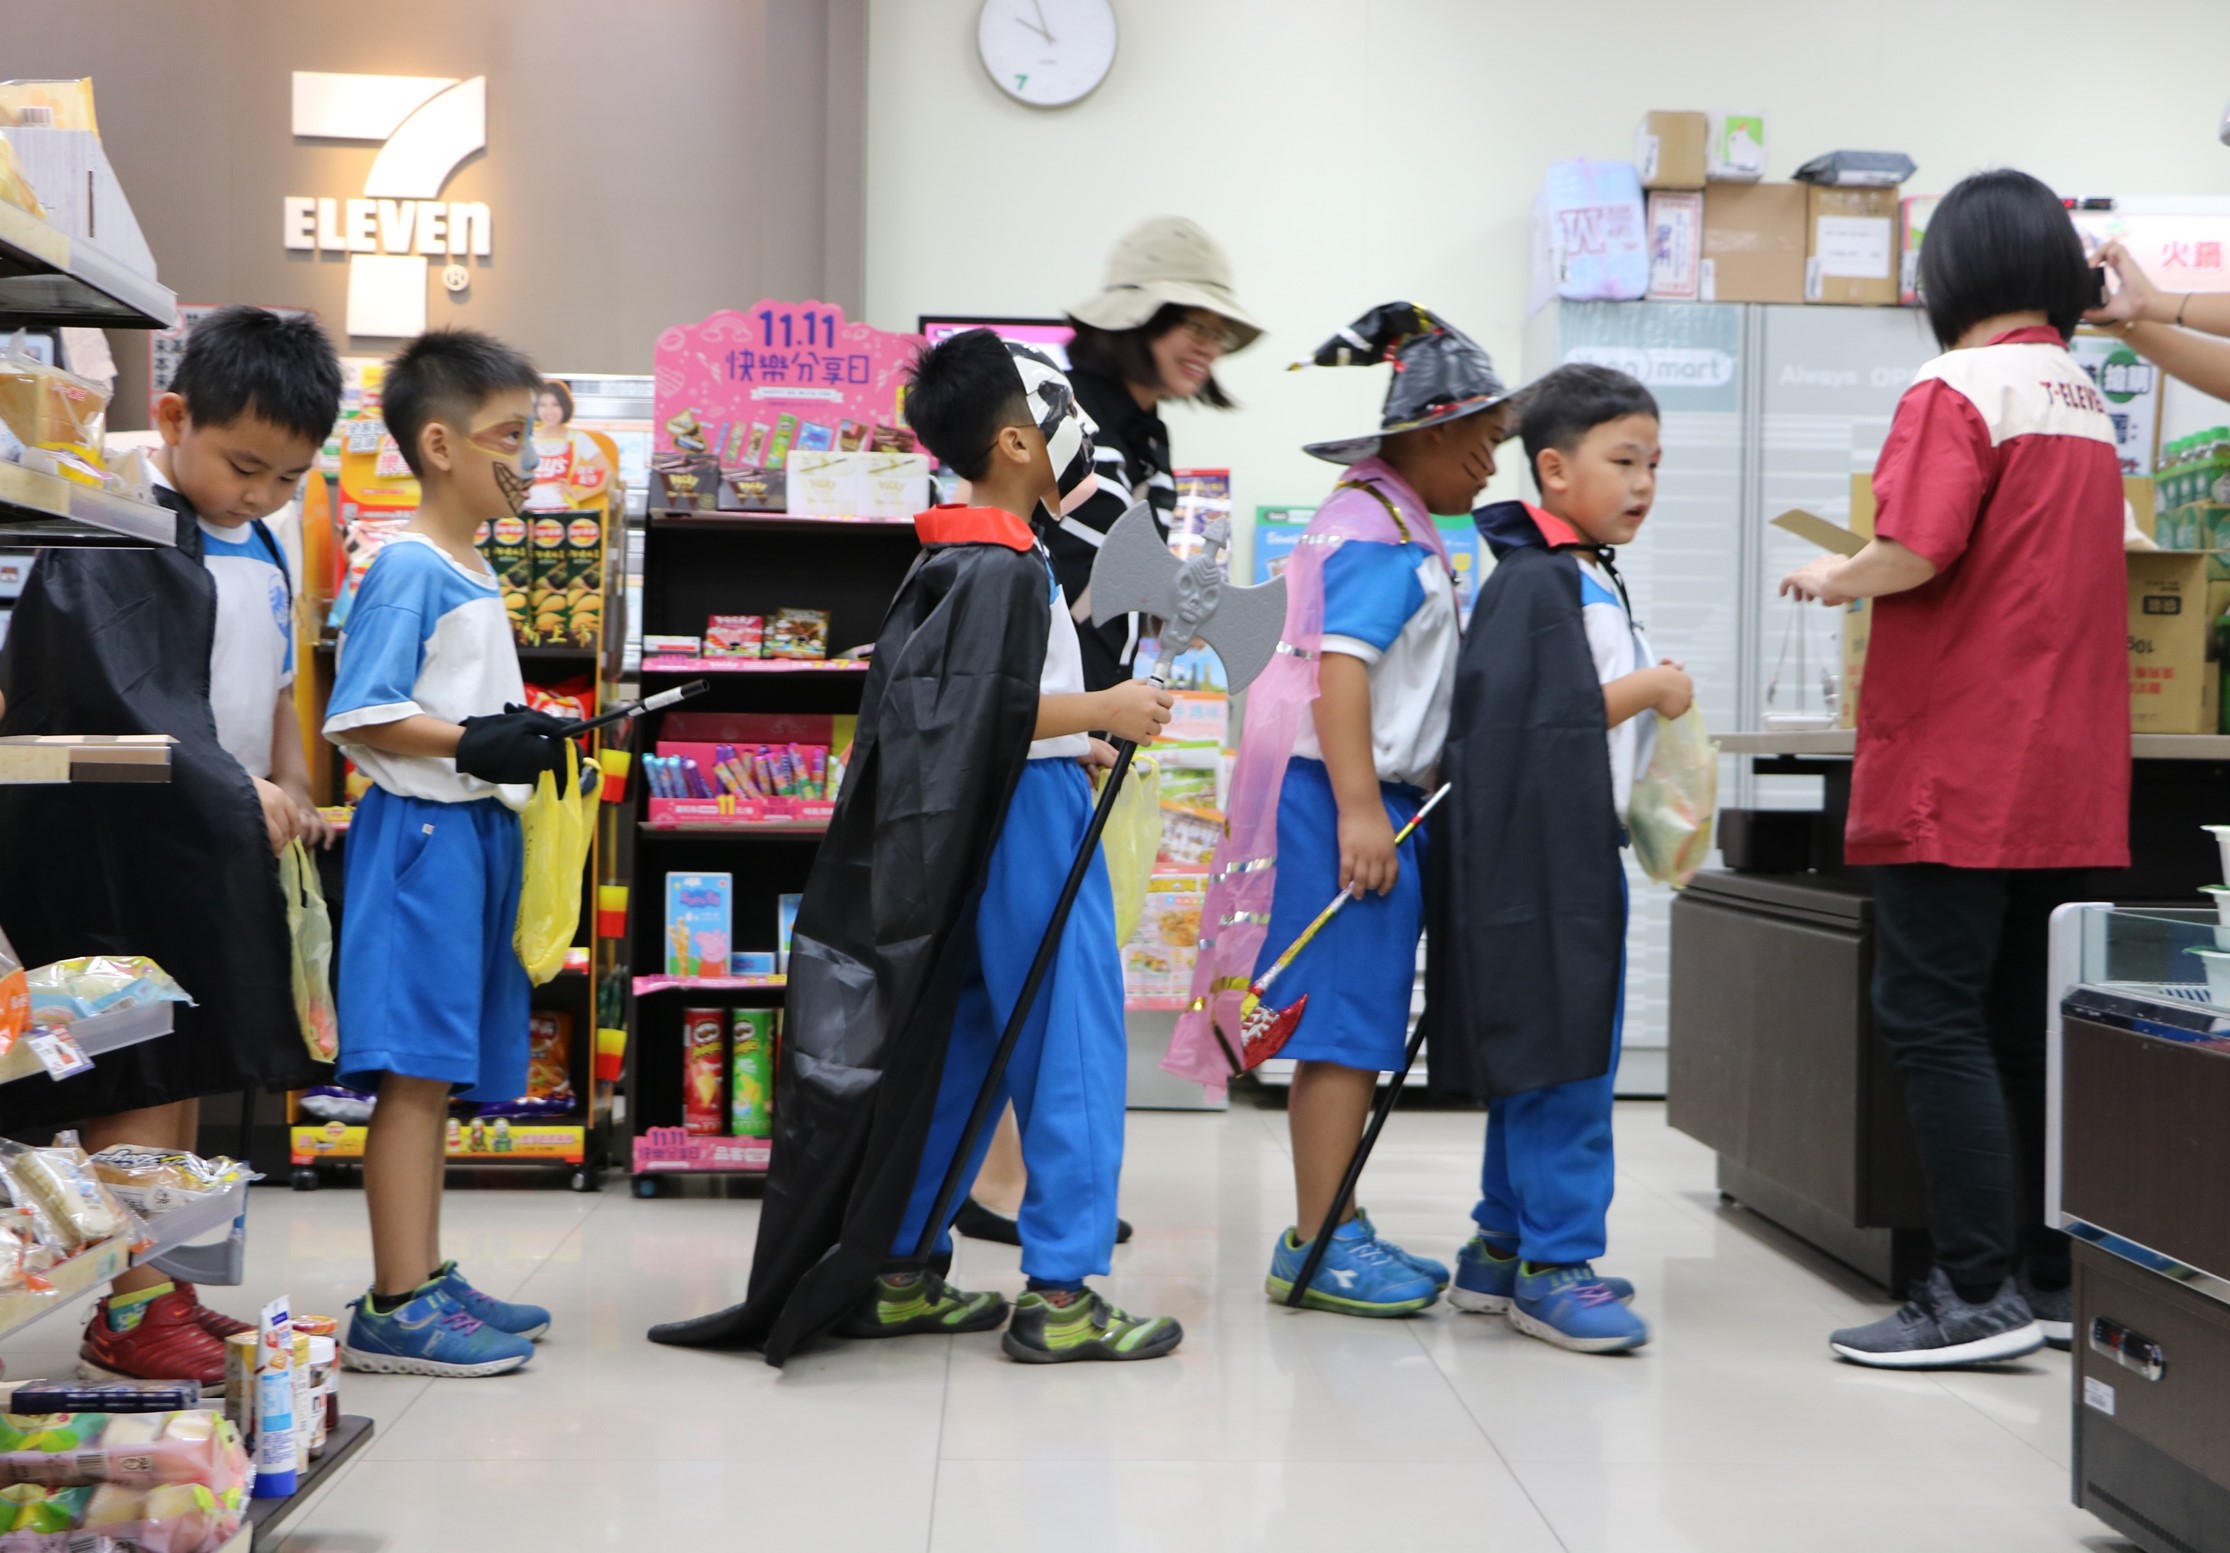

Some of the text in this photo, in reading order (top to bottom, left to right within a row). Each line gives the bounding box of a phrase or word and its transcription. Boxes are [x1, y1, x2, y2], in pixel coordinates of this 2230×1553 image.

[758, 310, 834, 348] 11.11
[725, 349, 869, 385] 快樂分享日
[1656, 356, 1720, 379] mart
